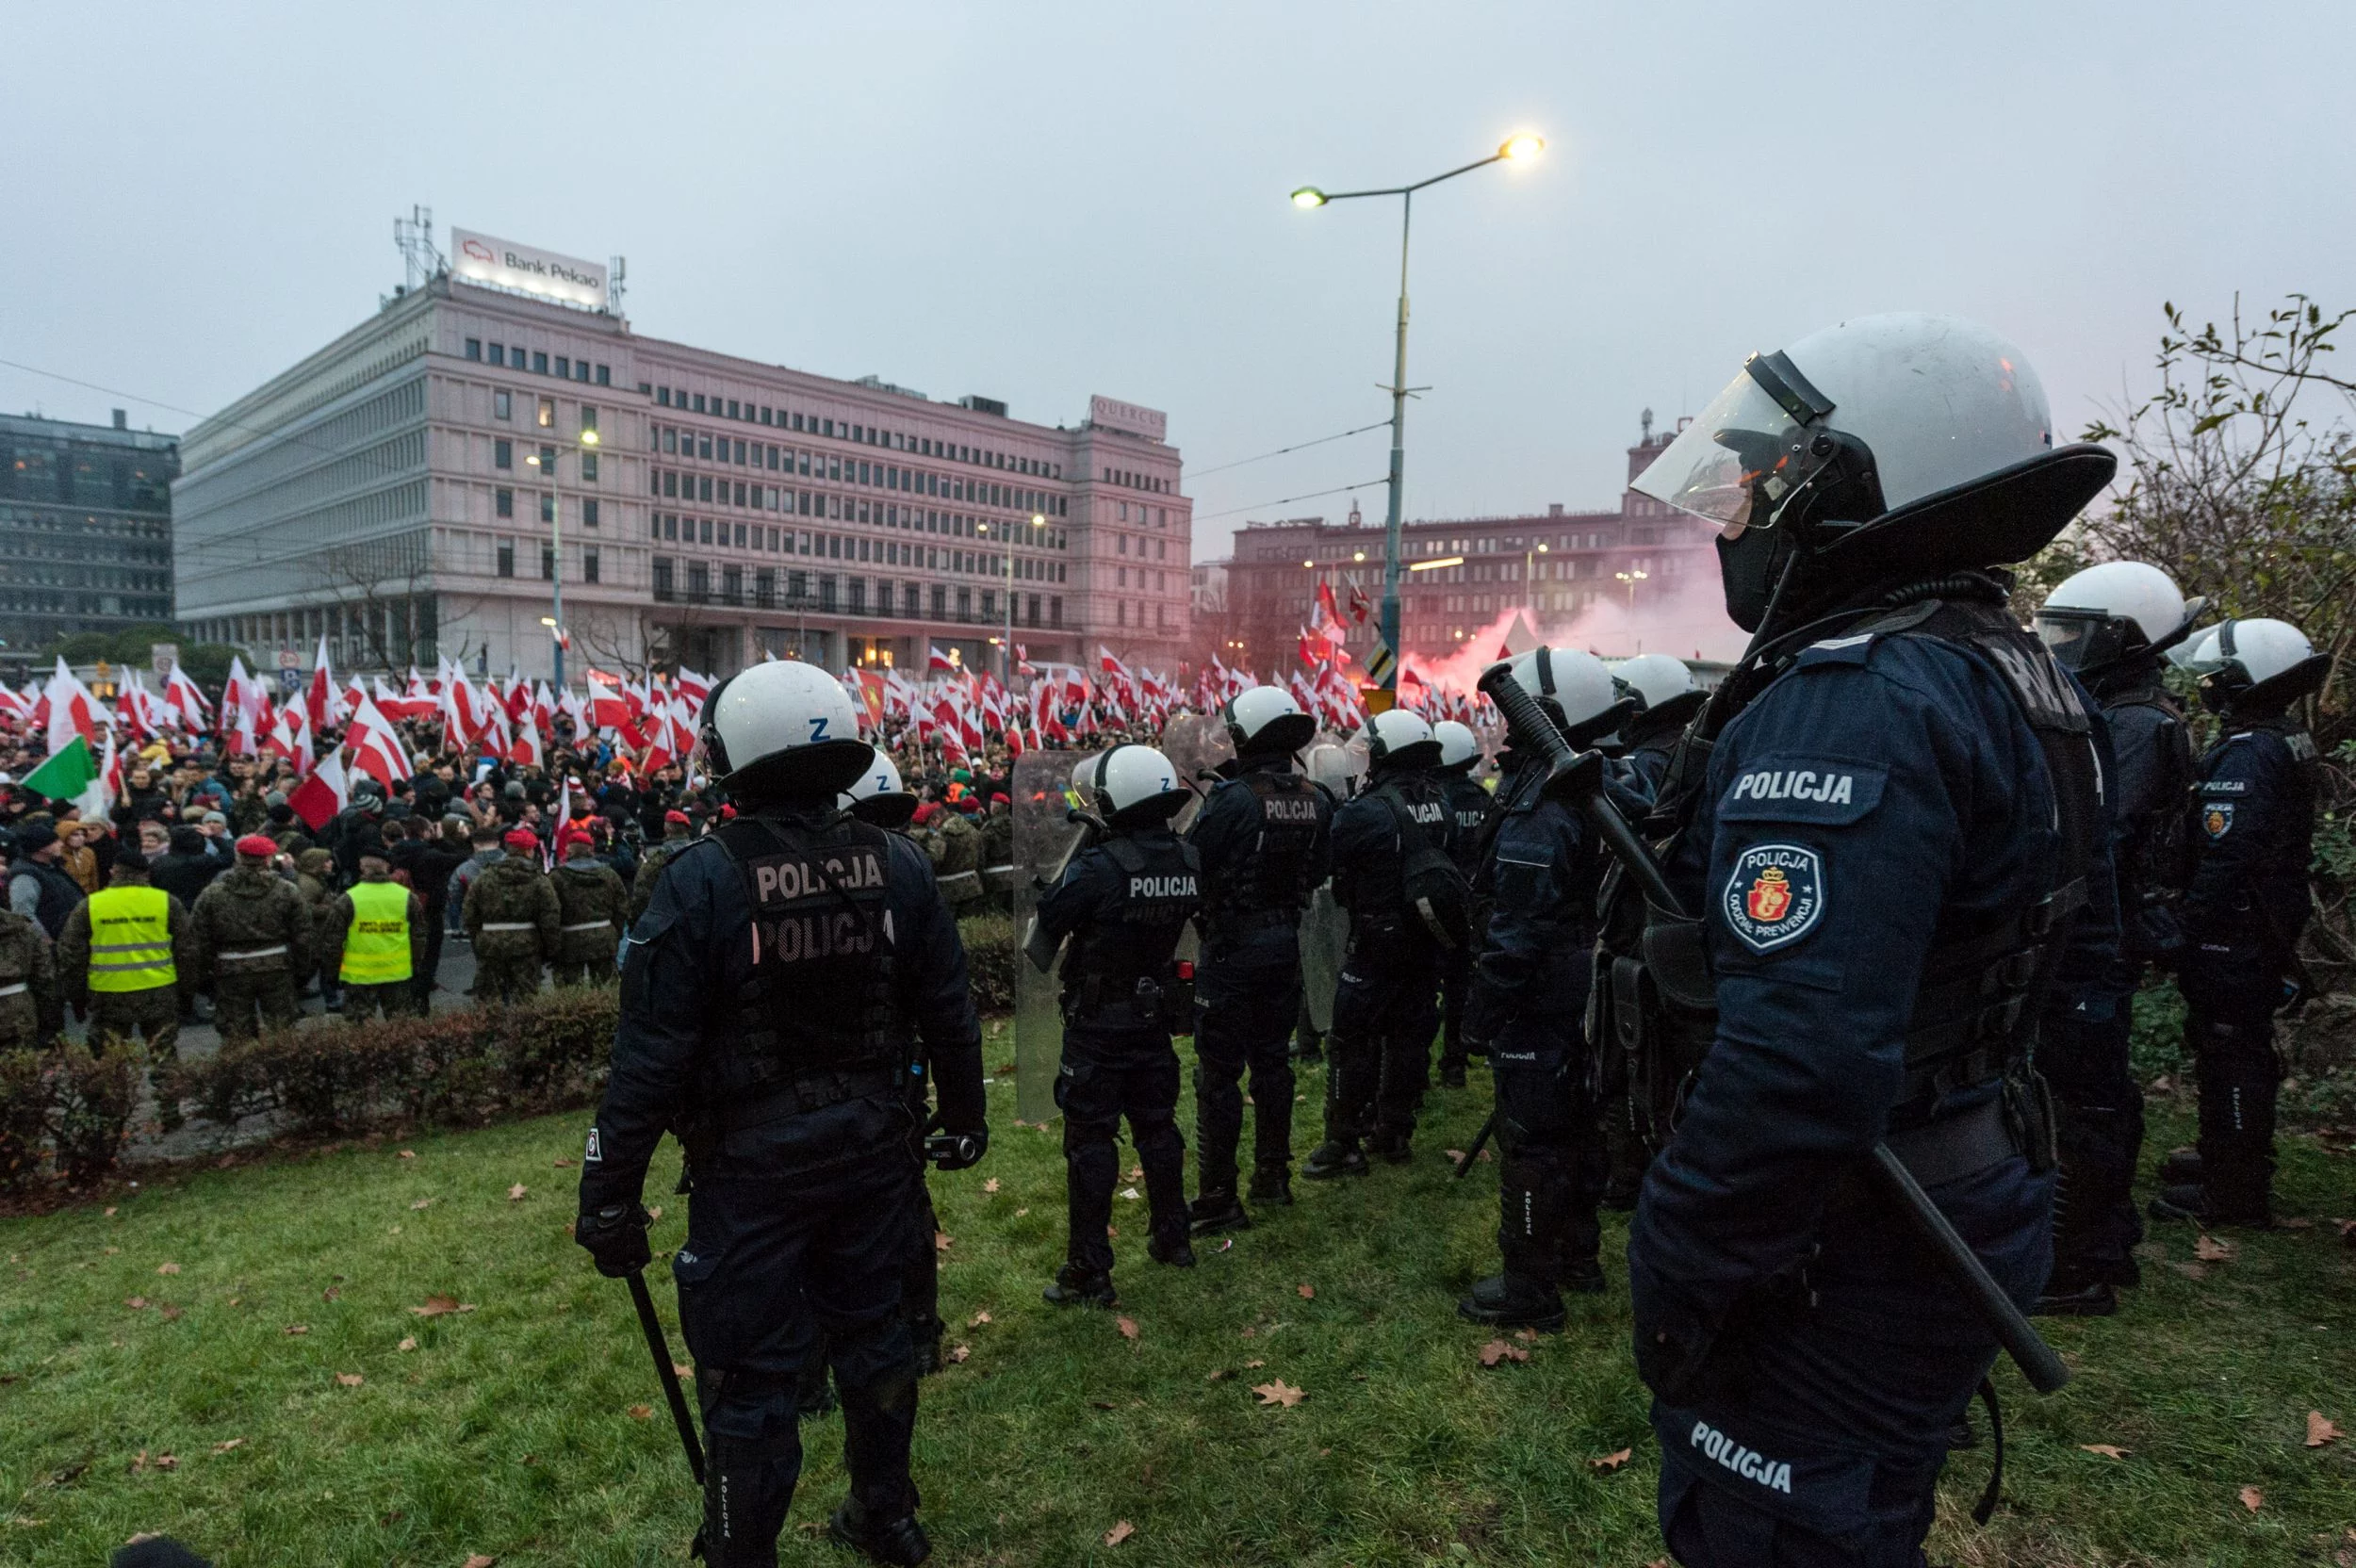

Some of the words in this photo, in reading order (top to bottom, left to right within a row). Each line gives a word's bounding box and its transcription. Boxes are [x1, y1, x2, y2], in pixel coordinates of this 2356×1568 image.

[505, 252, 548, 276] Bank
[550, 264, 599, 288] Pekao
[1096, 400, 1166, 426] QUERCUS
[810, 717, 830, 743] Z
[875, 776, 890, 792] Z
[1161, 778, 1170, 791] Z
[1733, 771, 1853, 804] POLICJA
[1266, 799, 1317, 820] POLICJA
[1747, 852, 1809, 872] POLICJA
[1130, 876, 1198, 897] POLICJA
[1729, 893, 1754, 934] ODDZIAŁ
[1754, 898, 1813, 937] PREWENCJI
[1691, 1420, 1792, 1494] POLICJA
[721, 1475, 731, 1539] POLICJA
